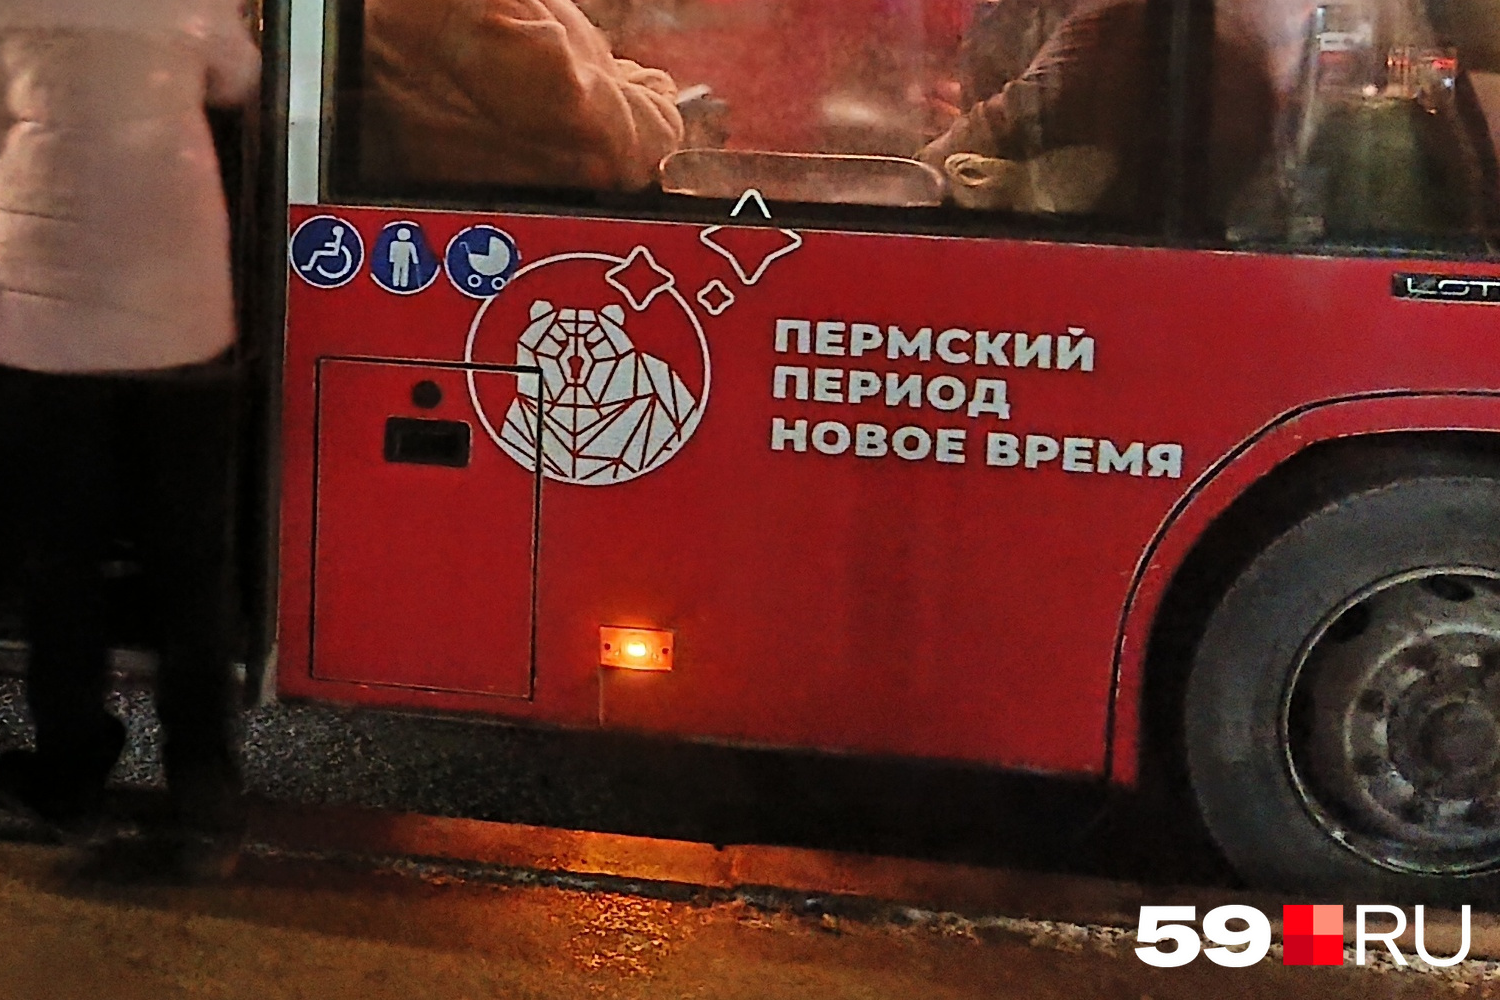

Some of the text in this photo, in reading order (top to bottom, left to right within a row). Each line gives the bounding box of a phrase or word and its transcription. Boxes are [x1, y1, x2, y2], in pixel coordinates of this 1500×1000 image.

[773, 318, 1096, 372] ПЕРМСКИЙ
[772, 365, 1012, 420] ПЕРИОД
[770, 417, 1184, 479] НОВОЕ ВРЕМЯ
